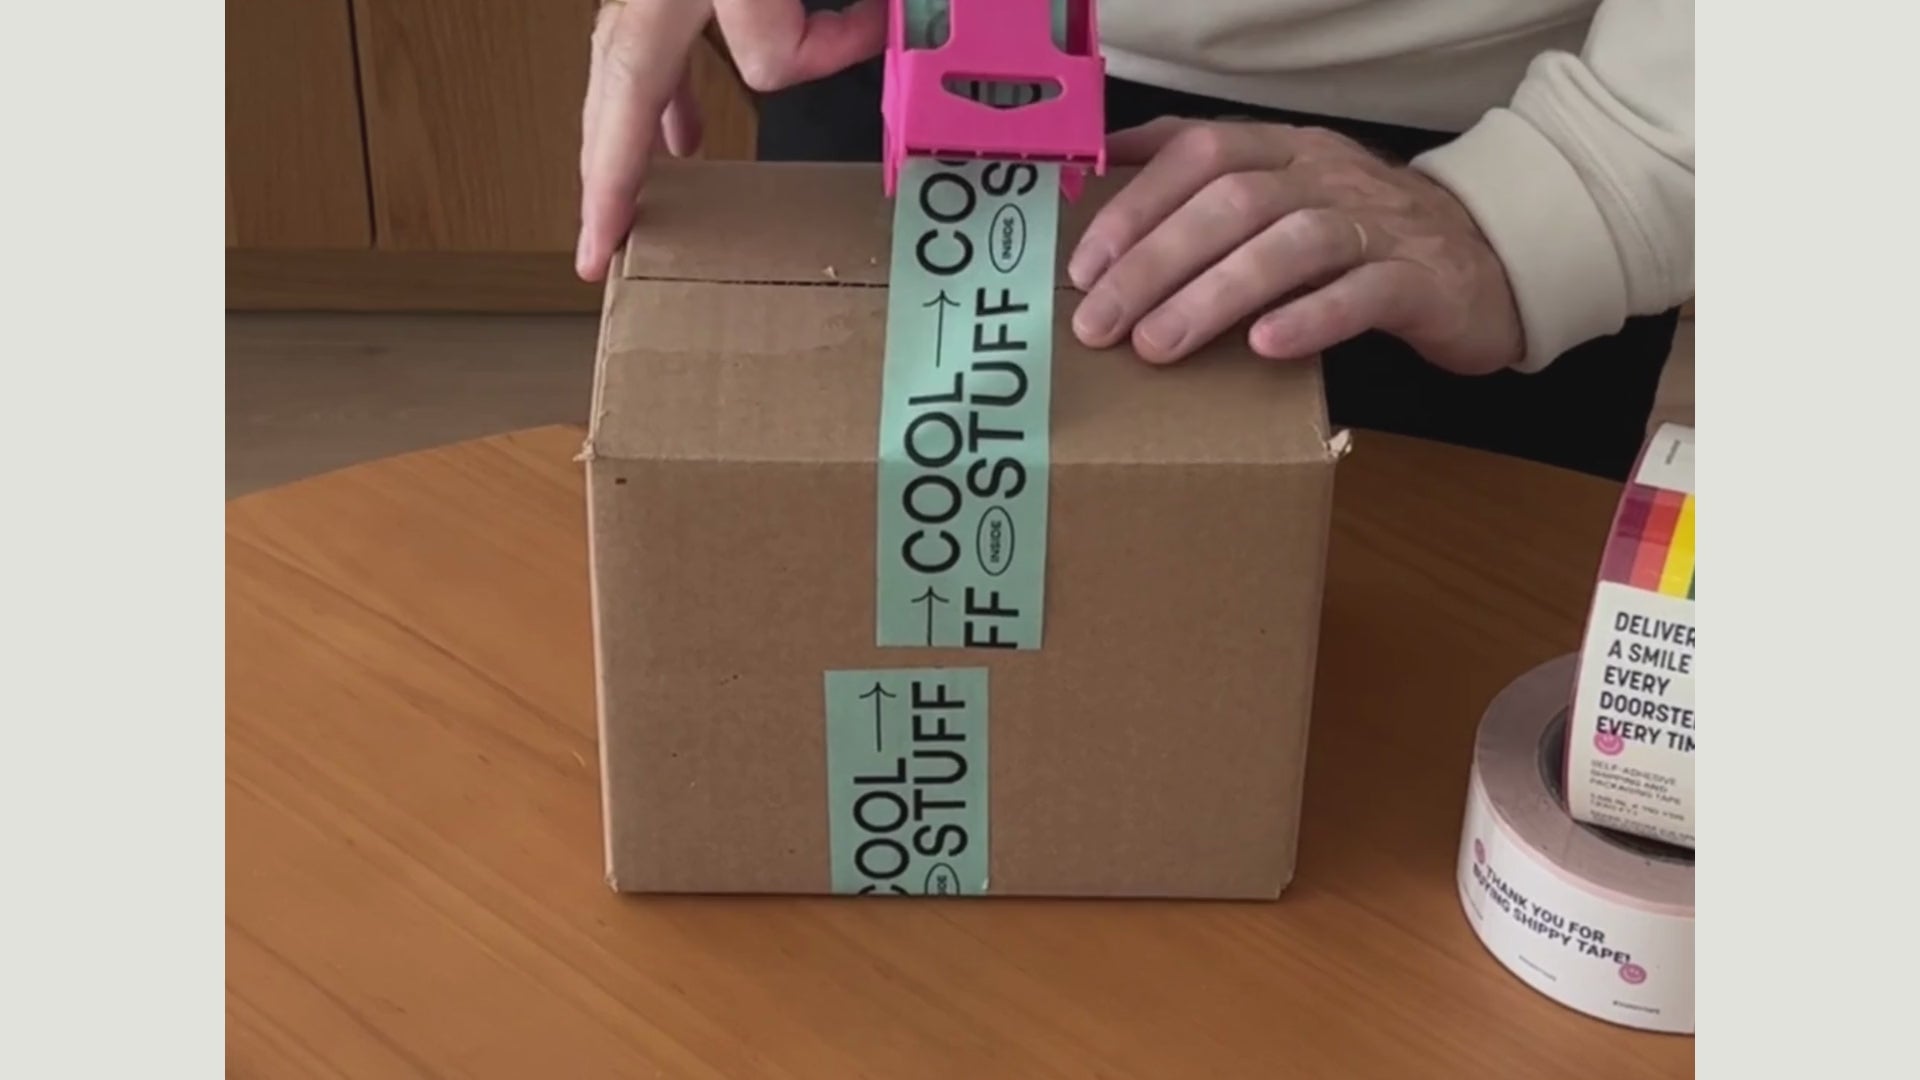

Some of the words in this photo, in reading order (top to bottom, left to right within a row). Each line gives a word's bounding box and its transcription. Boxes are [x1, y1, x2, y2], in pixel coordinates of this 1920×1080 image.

[915, 160, 977, 276] CO
[1002, 217, 1014, 260] INSIDE
[965, 288, 1029, 499] STUFF
[901, 372, 965, 576] COOL
[990, 520, 1002, 563] INSIDE
[1603, 665, 1671, 697] EVERY
[1607, 639, 1622, 659] A
[1628, 643, 1692, 675] SMILE
[1596, 715, 1662, 745] EVERY
[1600, 691, 1695, 730] DOORSTE
[912, 682, 968, 857] STUFF
[1486, 865, 1528, 909] THANK
[1532, 903, 1565, 930] YOU
[1568, 921, 1606, 944] FOR
[1513, 908, 1572, 947] SHIPPY
[1576, 938, 1631, 965] TAPE!
